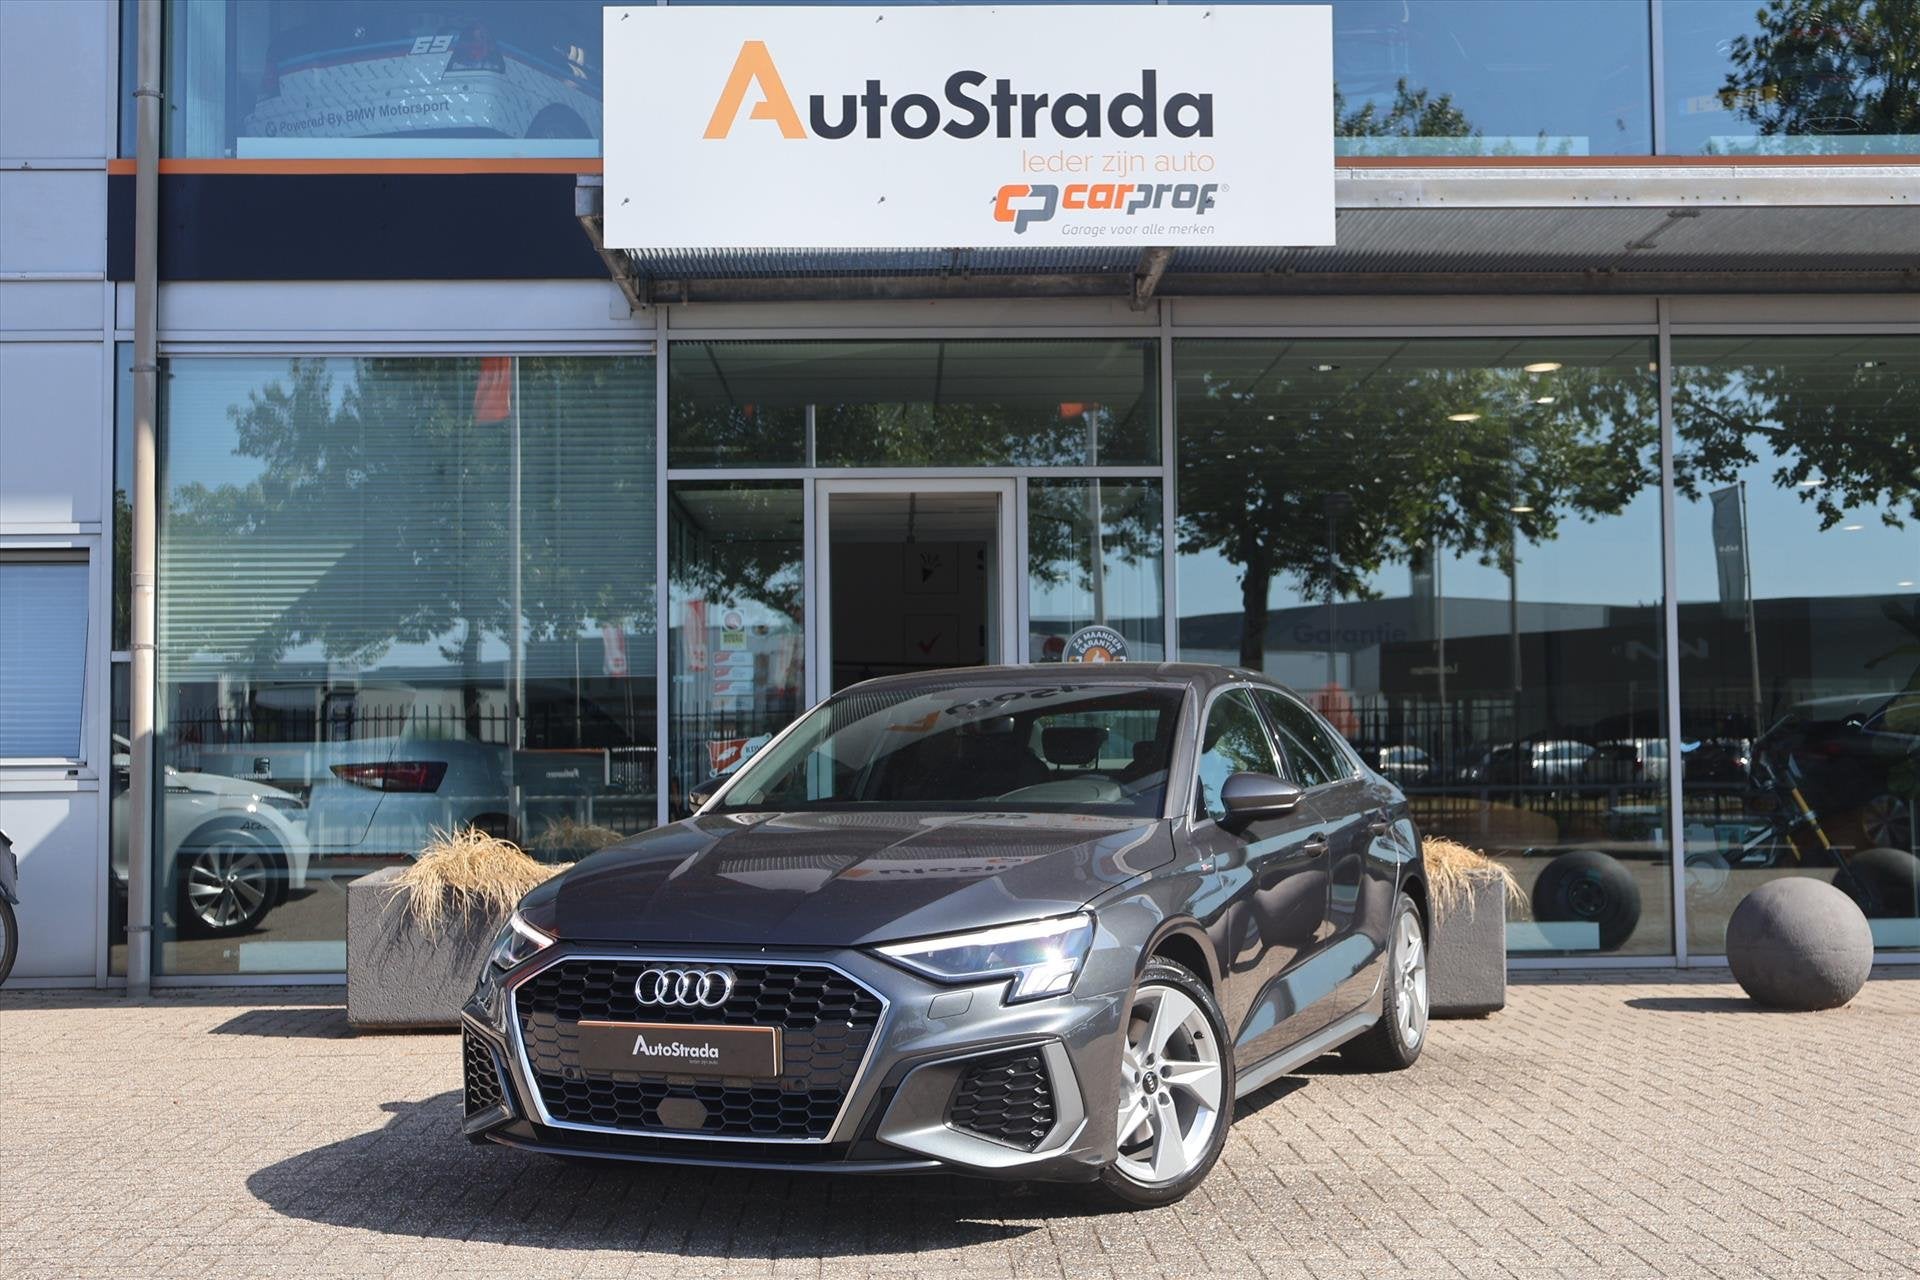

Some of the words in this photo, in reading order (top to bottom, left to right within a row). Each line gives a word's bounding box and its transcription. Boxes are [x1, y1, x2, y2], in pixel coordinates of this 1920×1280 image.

[409, 35, 453, 54] 69
[702, 41, 1213, 139] AutoStrada
[279, 115, 324, 132] Powered
[328, 113, 341, 126] By
[346, 109, 376, 122] BMW
[379, 100, 449, 117] Motorsport
[1022, 150, 1093, 172] Ieder
[1102, 150, 1144, 177] zijn
[1155, 153, 1215, 173] auto
[1061, 184, 1218, 215] carprof
[1062, 224, 1105, 237] Garage
[1111, 226, 1137, 235] voor
[1142, 225, 1164, 235] alle
[1169, 224, 1215, 235] merken
[1073, 639, 1083, 649] 24
[1083, 632, 1122, 649] MAANDEN
[1294, 623, 1406, 645] Garantie
[1079, 640, 1116, 654] GARANTIE
[632, 1034, 719, 1059] AutoStrada
